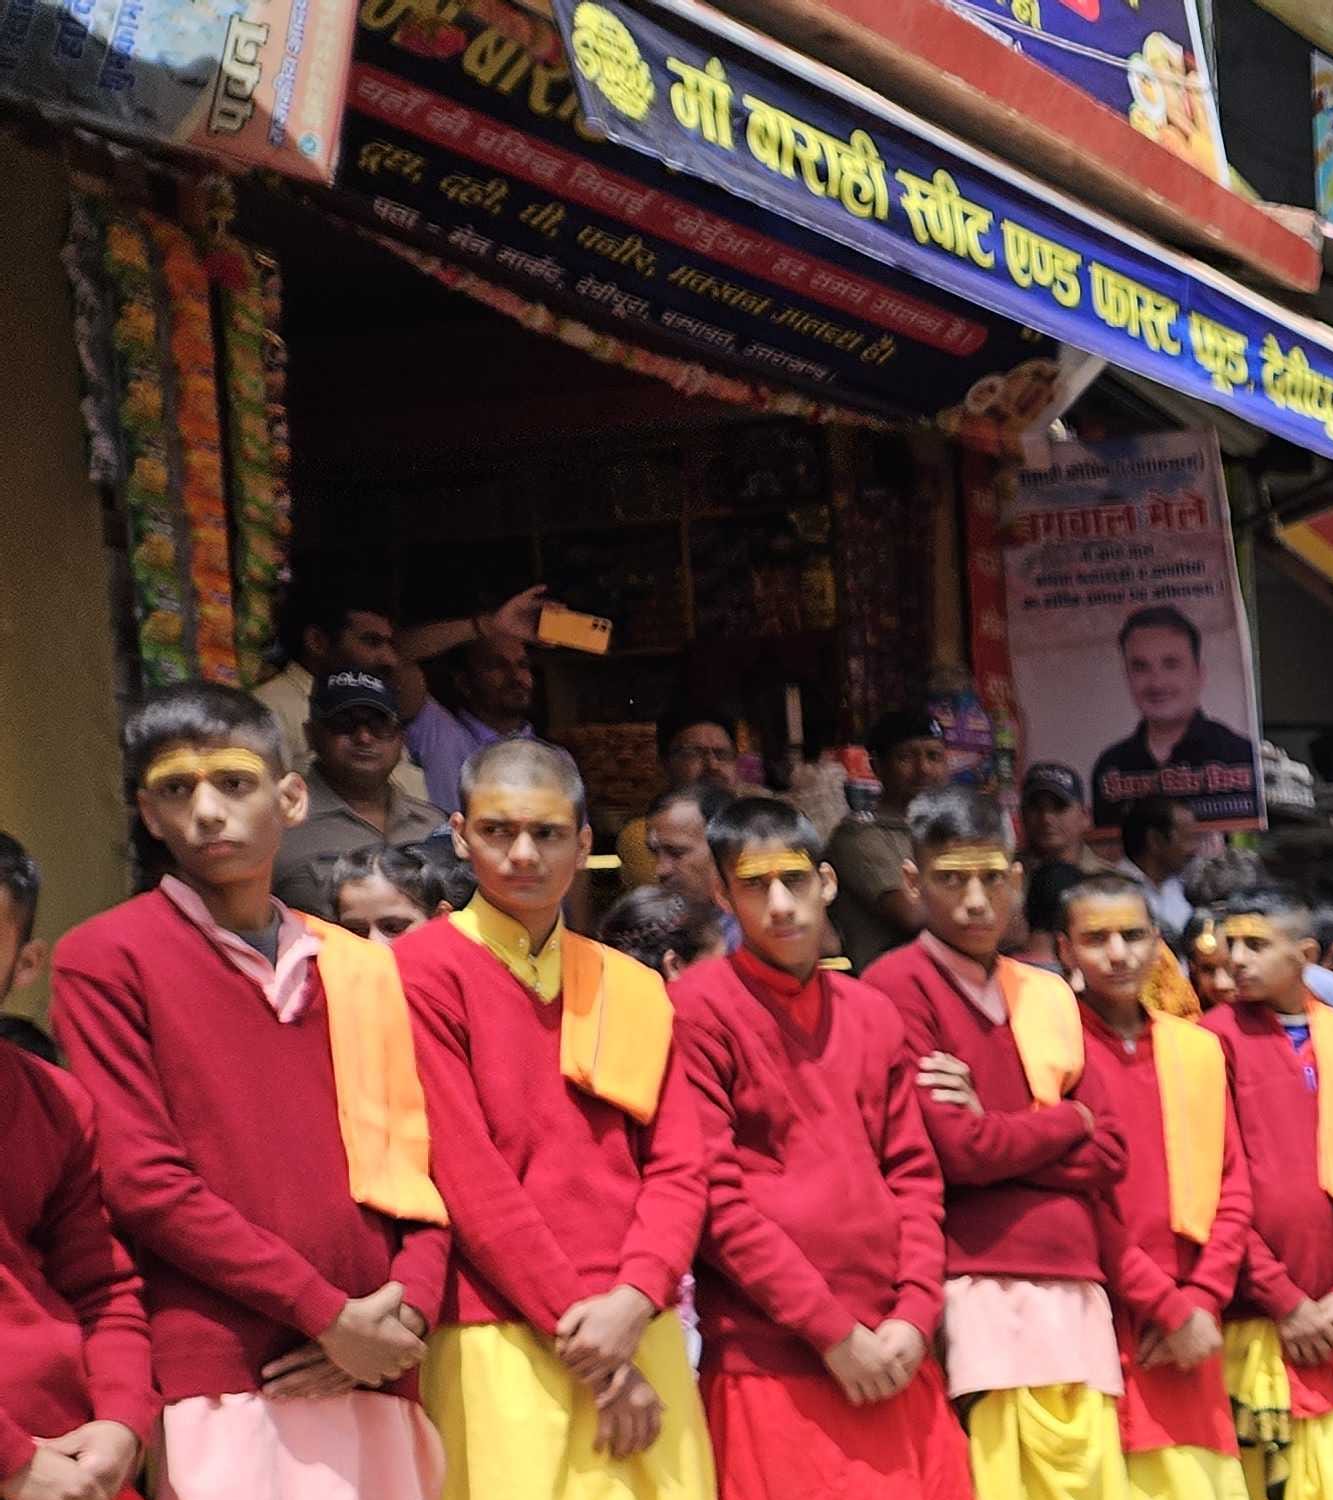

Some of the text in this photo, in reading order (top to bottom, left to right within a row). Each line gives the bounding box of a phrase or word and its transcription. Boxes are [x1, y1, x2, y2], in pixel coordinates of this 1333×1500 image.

[895, 168, 996, 269] स्वीट
[1000, 218, 1082, 308] एण्ड
[1089, 261, 1183, 356] फास्ट
